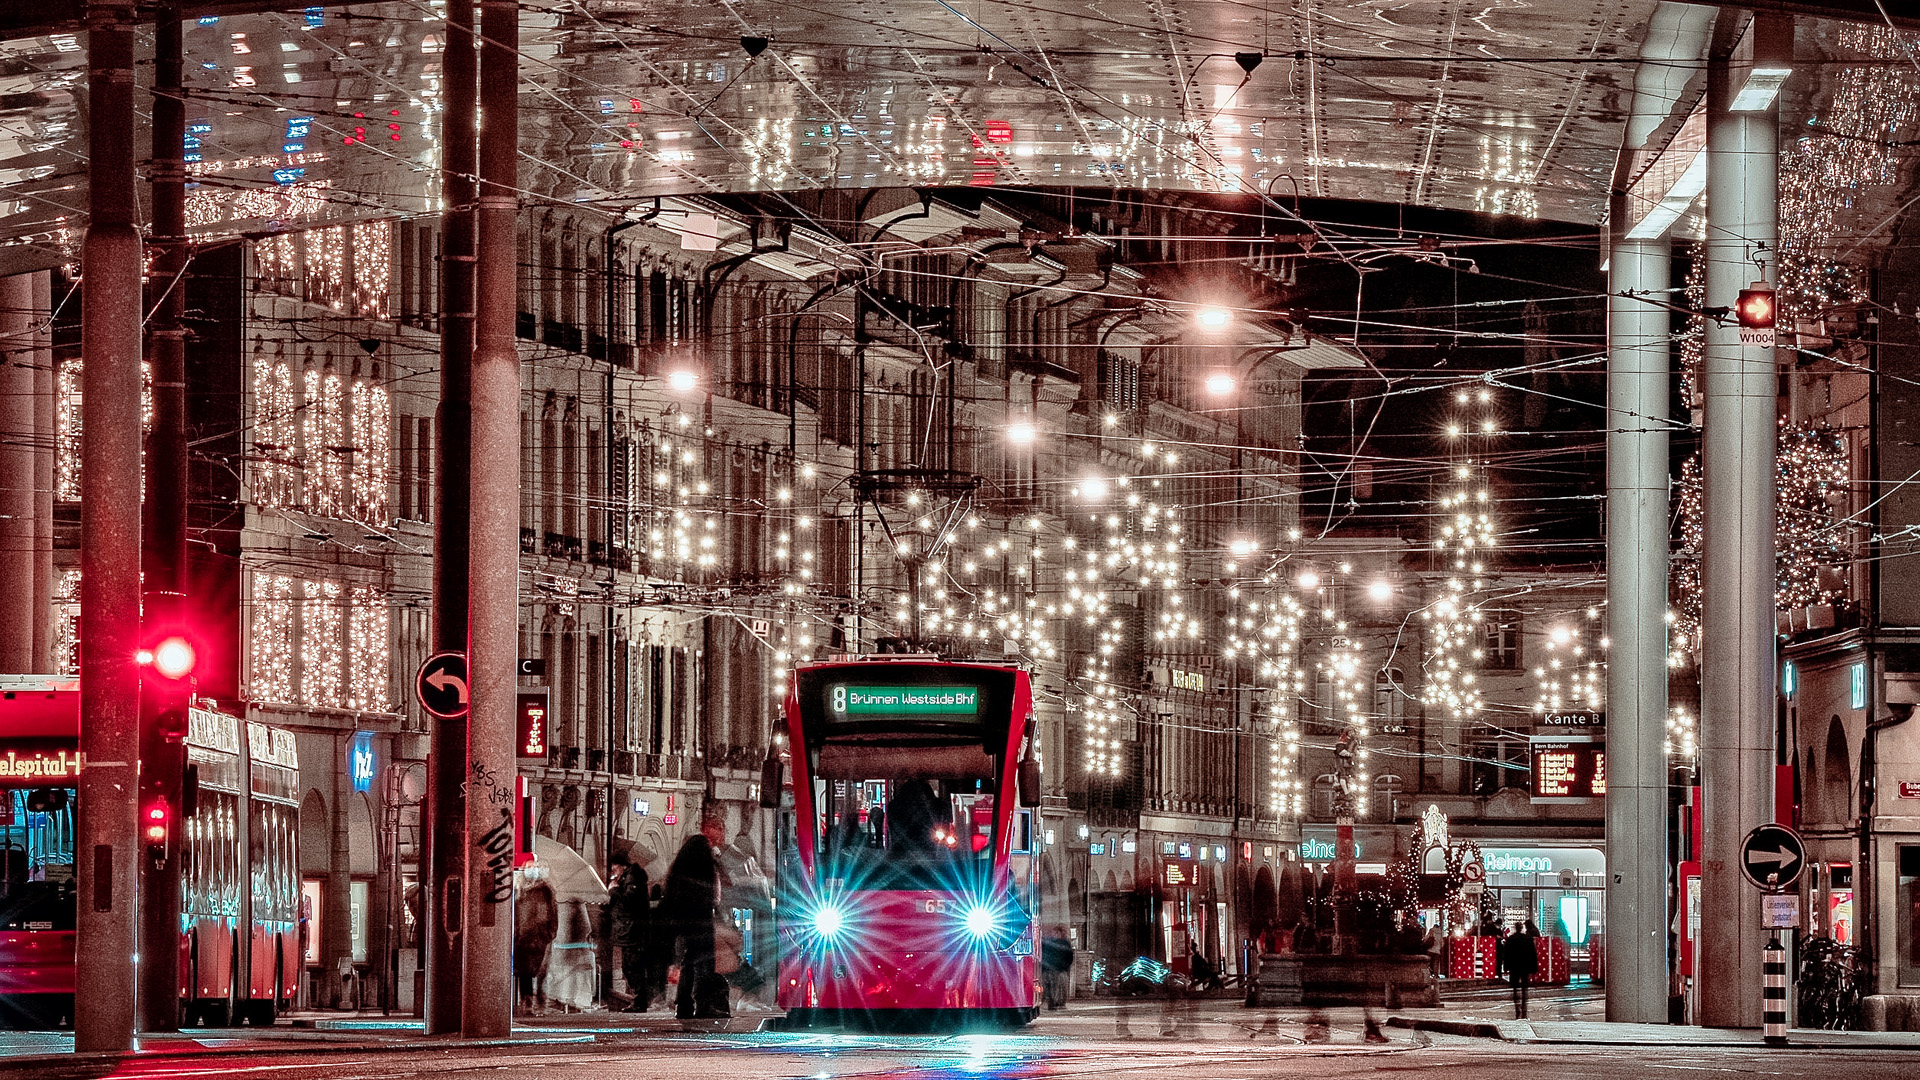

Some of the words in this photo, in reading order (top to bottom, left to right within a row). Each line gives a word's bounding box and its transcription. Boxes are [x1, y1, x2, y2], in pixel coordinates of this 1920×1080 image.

[1740, 333, 1774, 343] W1004
[522, 660, 532, 673] C
[833, 686, 846, 712] 8
[850, 692, 899, 705] Brünnen
[902, 692, 954, 705] Westside
[955, 693, 975, 705] Bhf
[1544, 713, 1586, 725] Kante
[1592, 713, 1600, 724] B
[23, 921, 52, 930] HESS
